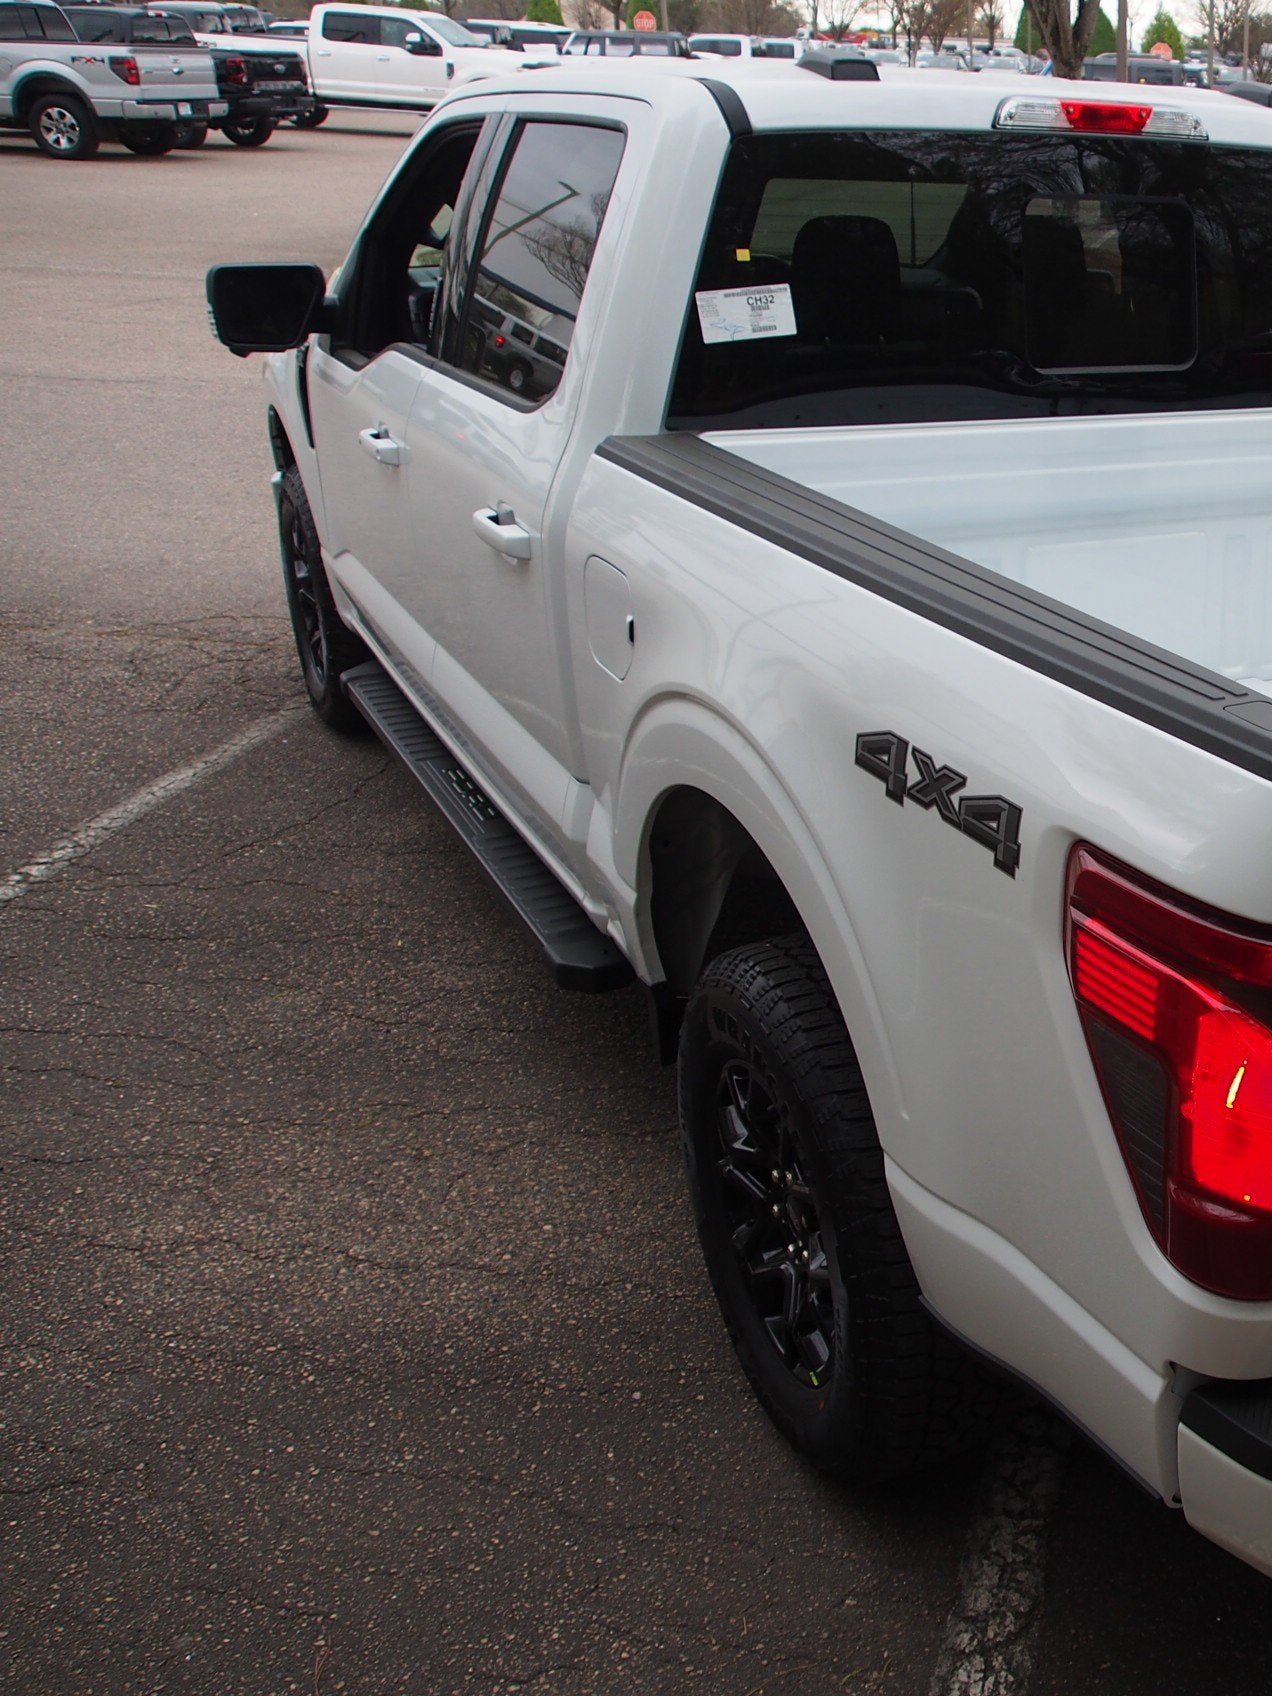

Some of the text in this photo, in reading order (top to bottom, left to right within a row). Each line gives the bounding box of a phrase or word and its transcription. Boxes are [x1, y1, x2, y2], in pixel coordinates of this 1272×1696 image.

[635, 18, 655, 27] STOP
[71, 56, 105, 64] FX4
[746, 294, 775, 306] CH32
